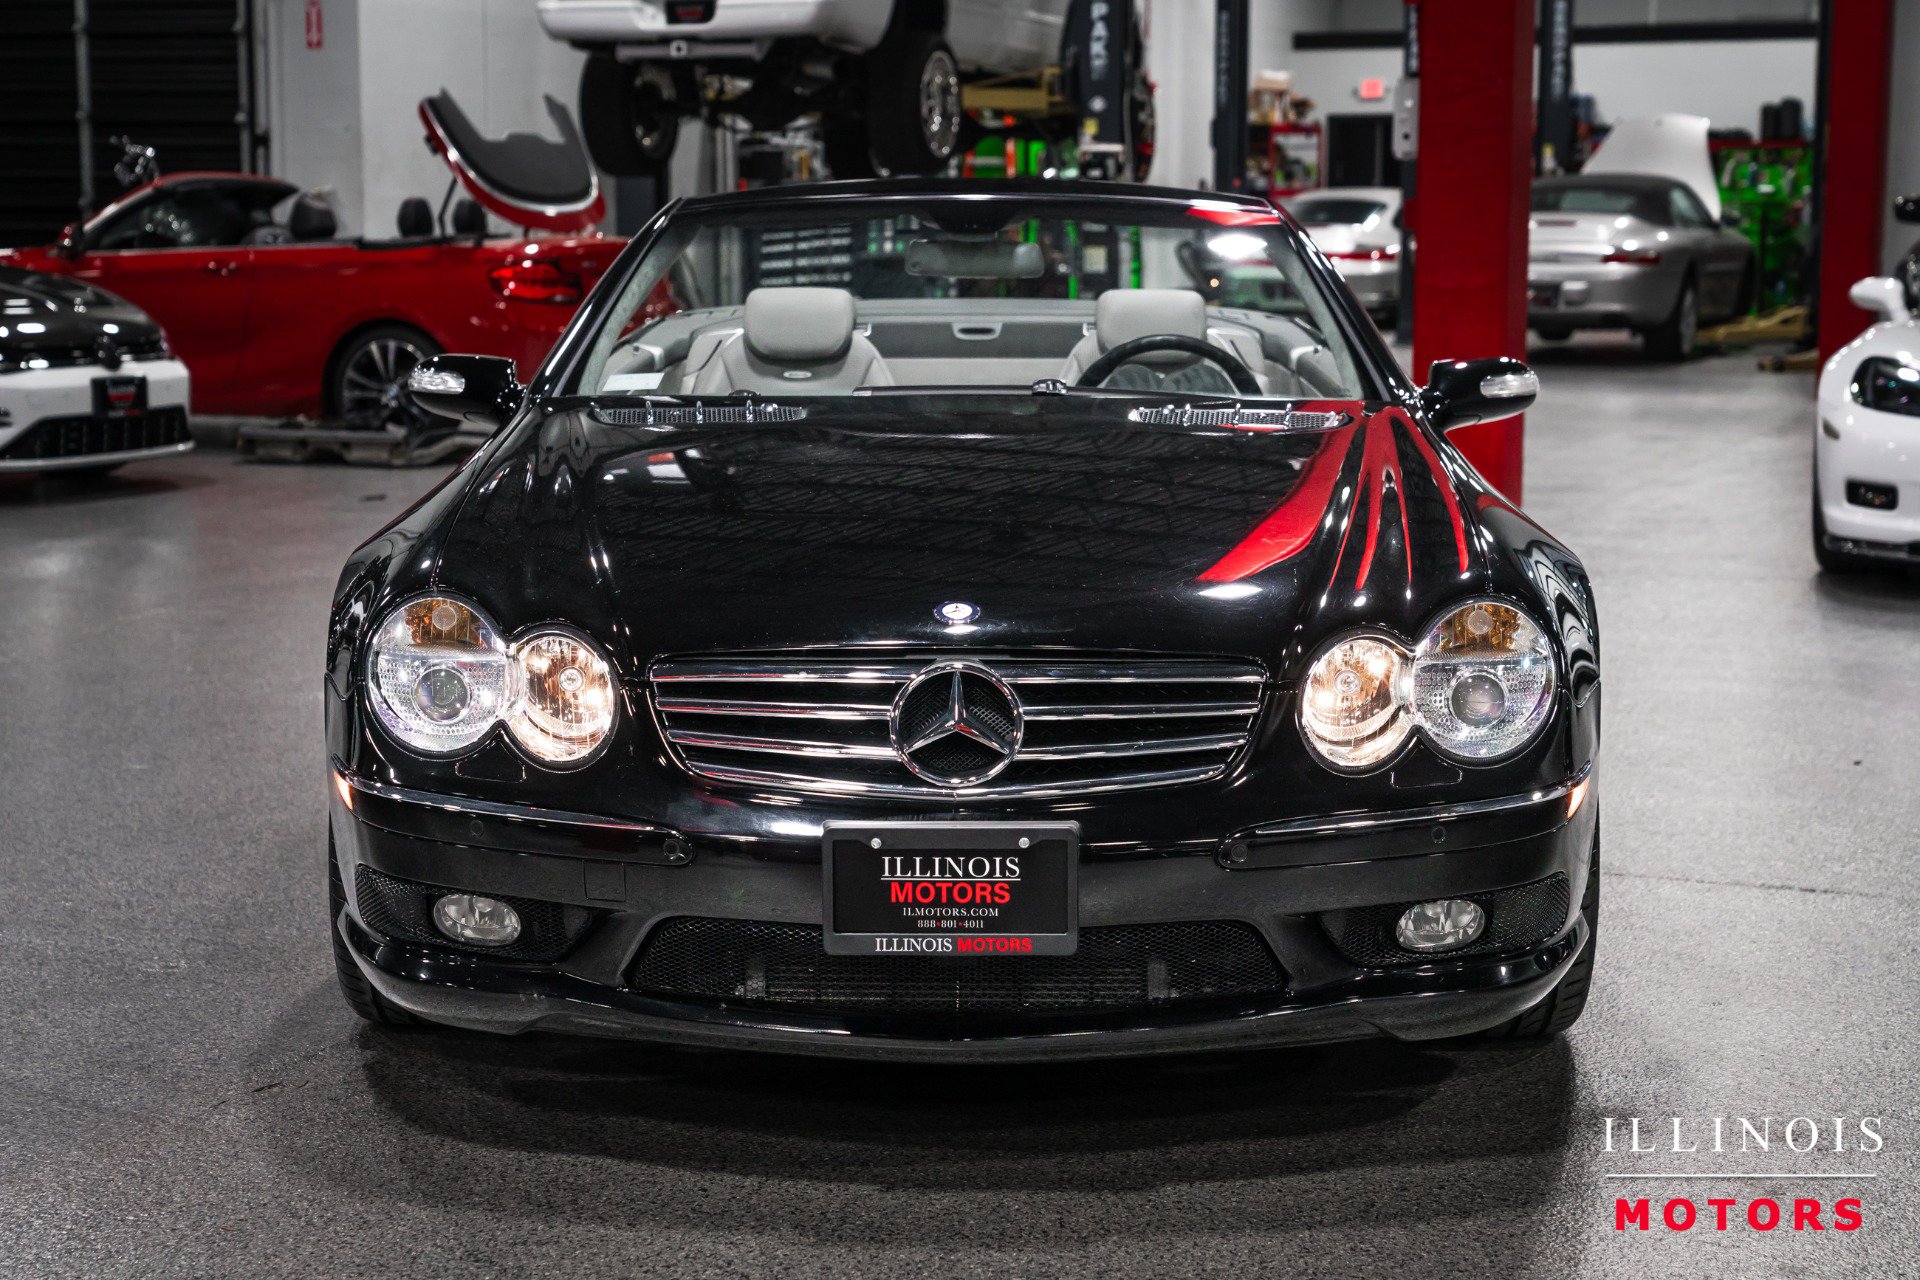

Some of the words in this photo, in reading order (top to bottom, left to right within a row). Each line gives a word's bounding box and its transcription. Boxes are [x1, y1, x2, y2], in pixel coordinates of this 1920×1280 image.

[881, 856, 1021, 878] ILLINOIS
[890, 881, 1011, 904] MOTORS
[903, 907, 999, 917] ILMOTORS.COM
[875, 938, 953, 952] ILLINOIS
[957, 938, 1033, 952] MOTORS
